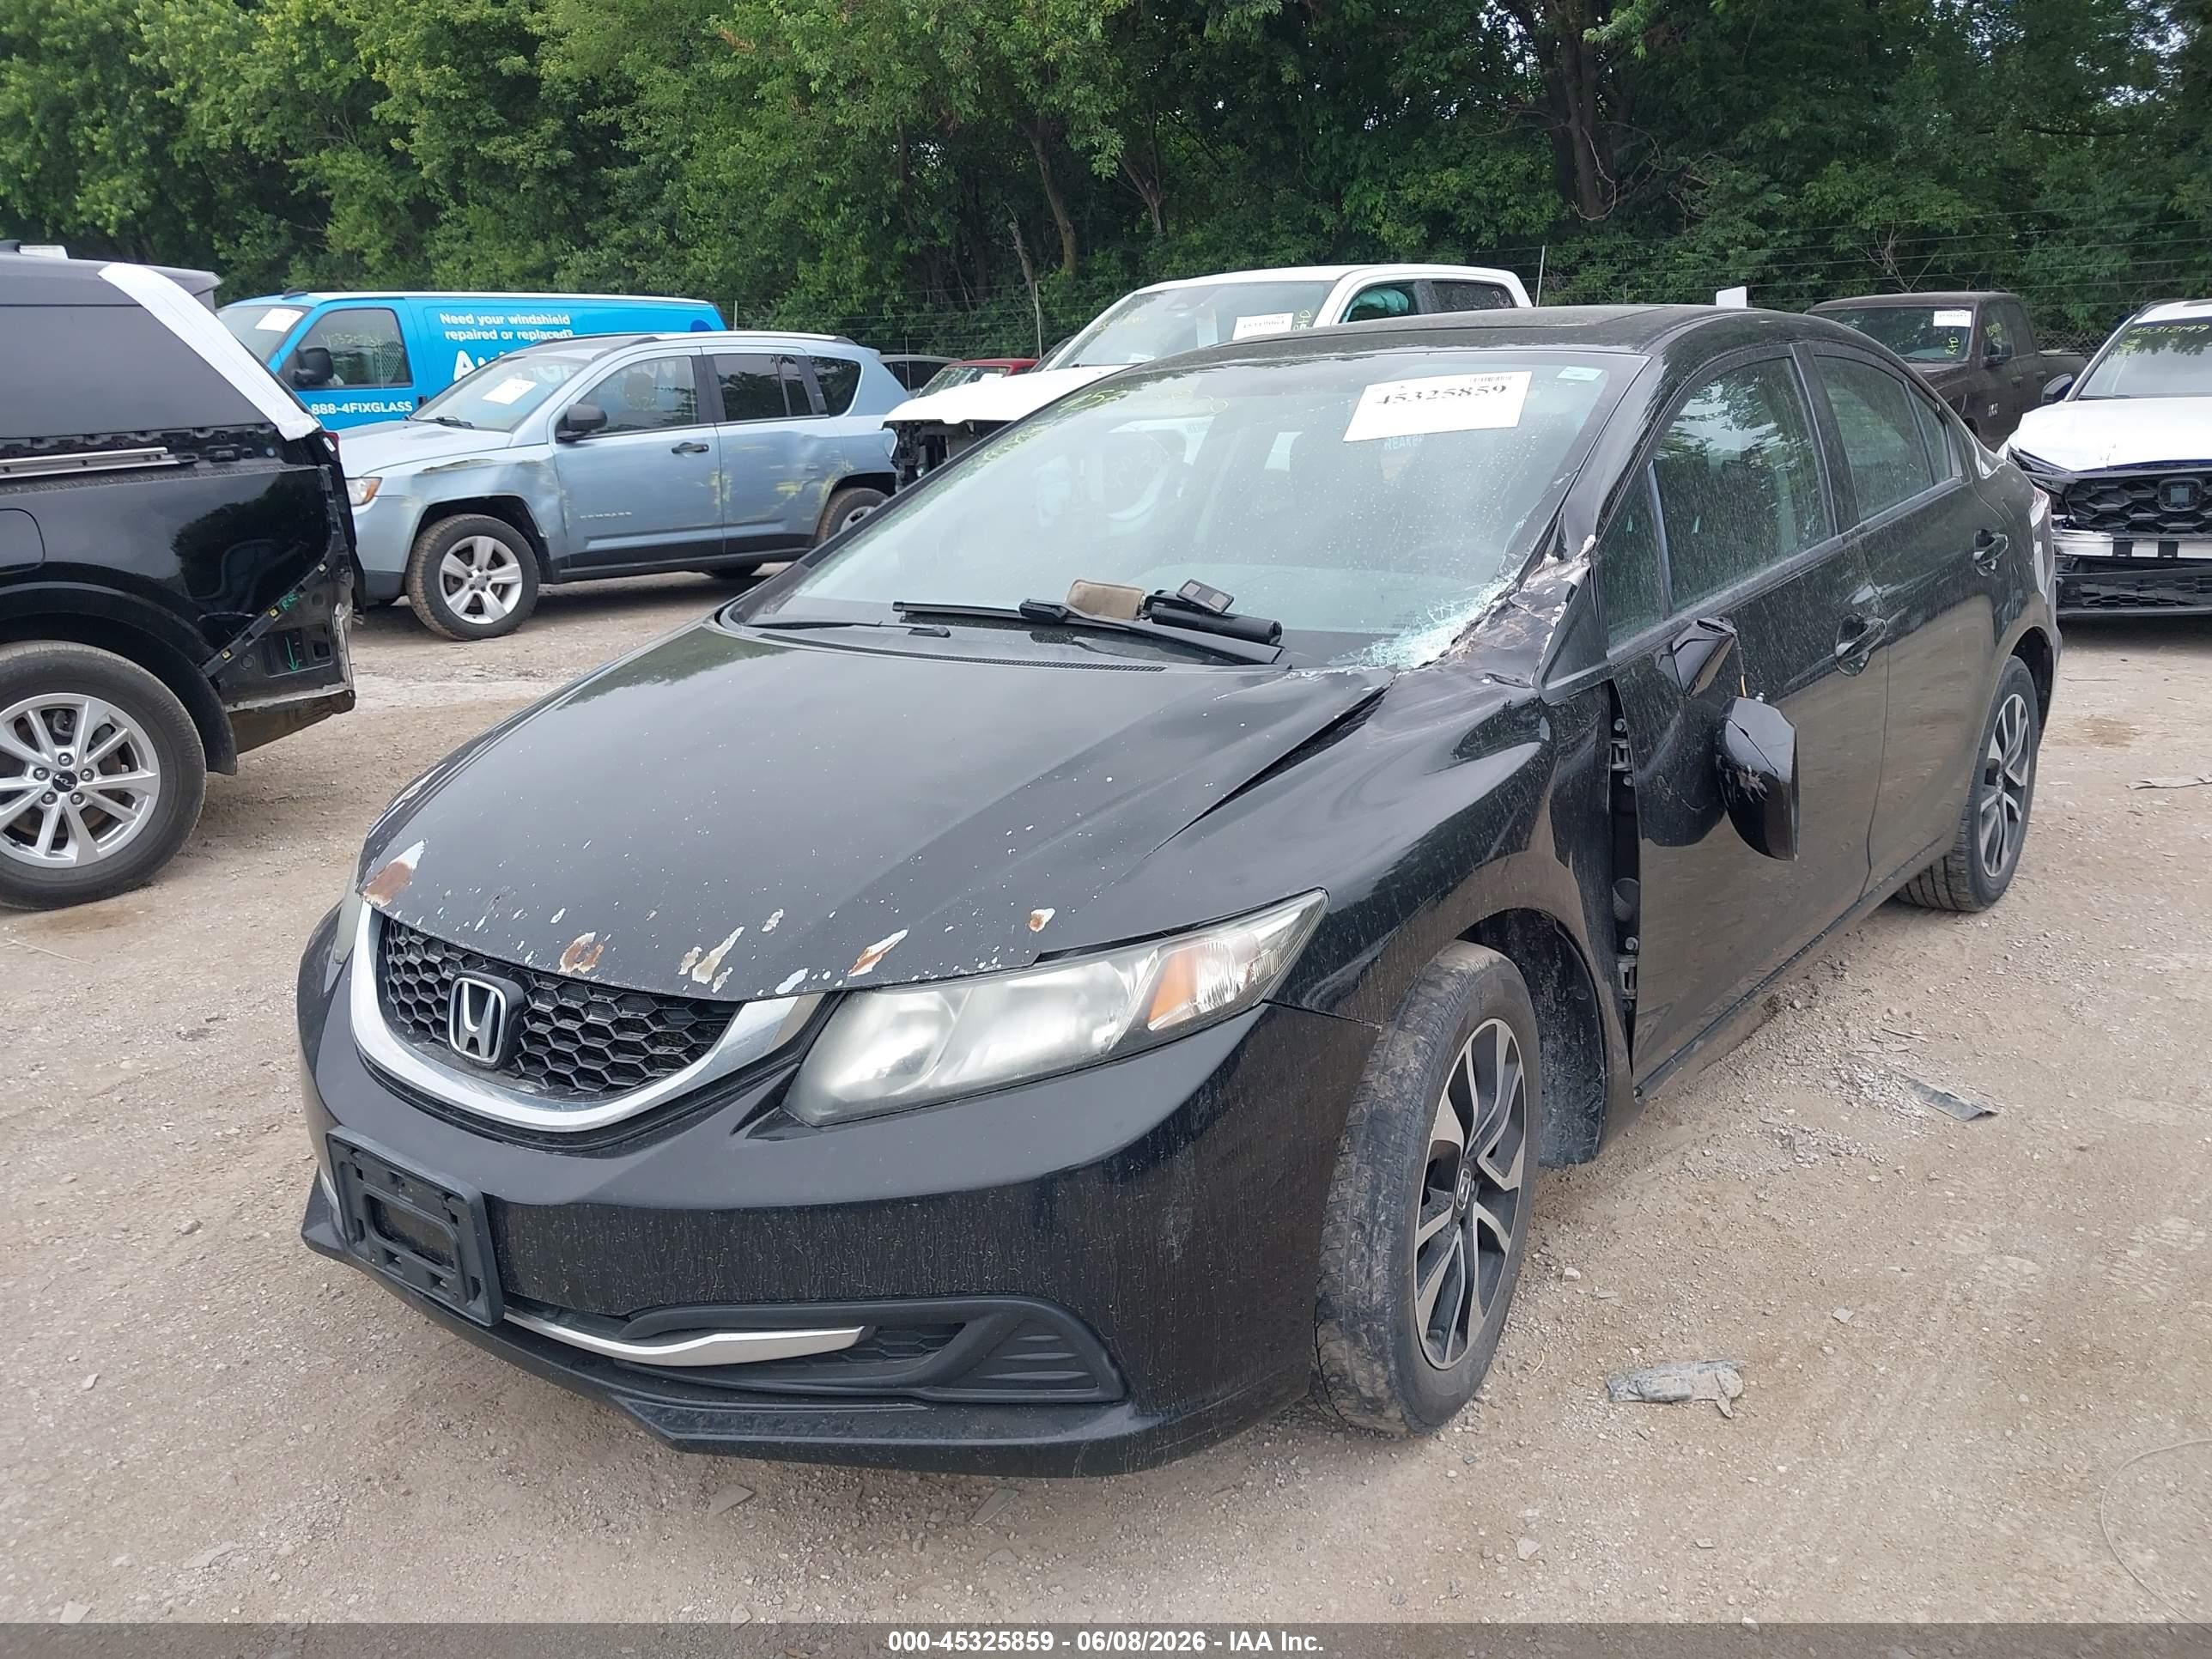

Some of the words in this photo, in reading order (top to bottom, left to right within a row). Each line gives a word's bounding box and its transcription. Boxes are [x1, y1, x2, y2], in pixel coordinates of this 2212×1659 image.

[440, 313, 474, 325] Need
[477, 314, 505, 326] your
[507, 313, 570, 325] windshield
[445, 329, 498, 342] repaired
[501, 331, 514, 341] or
[517, 329, 574, 341] replaced?
[1376, 385, 1508, 405] 45325859
